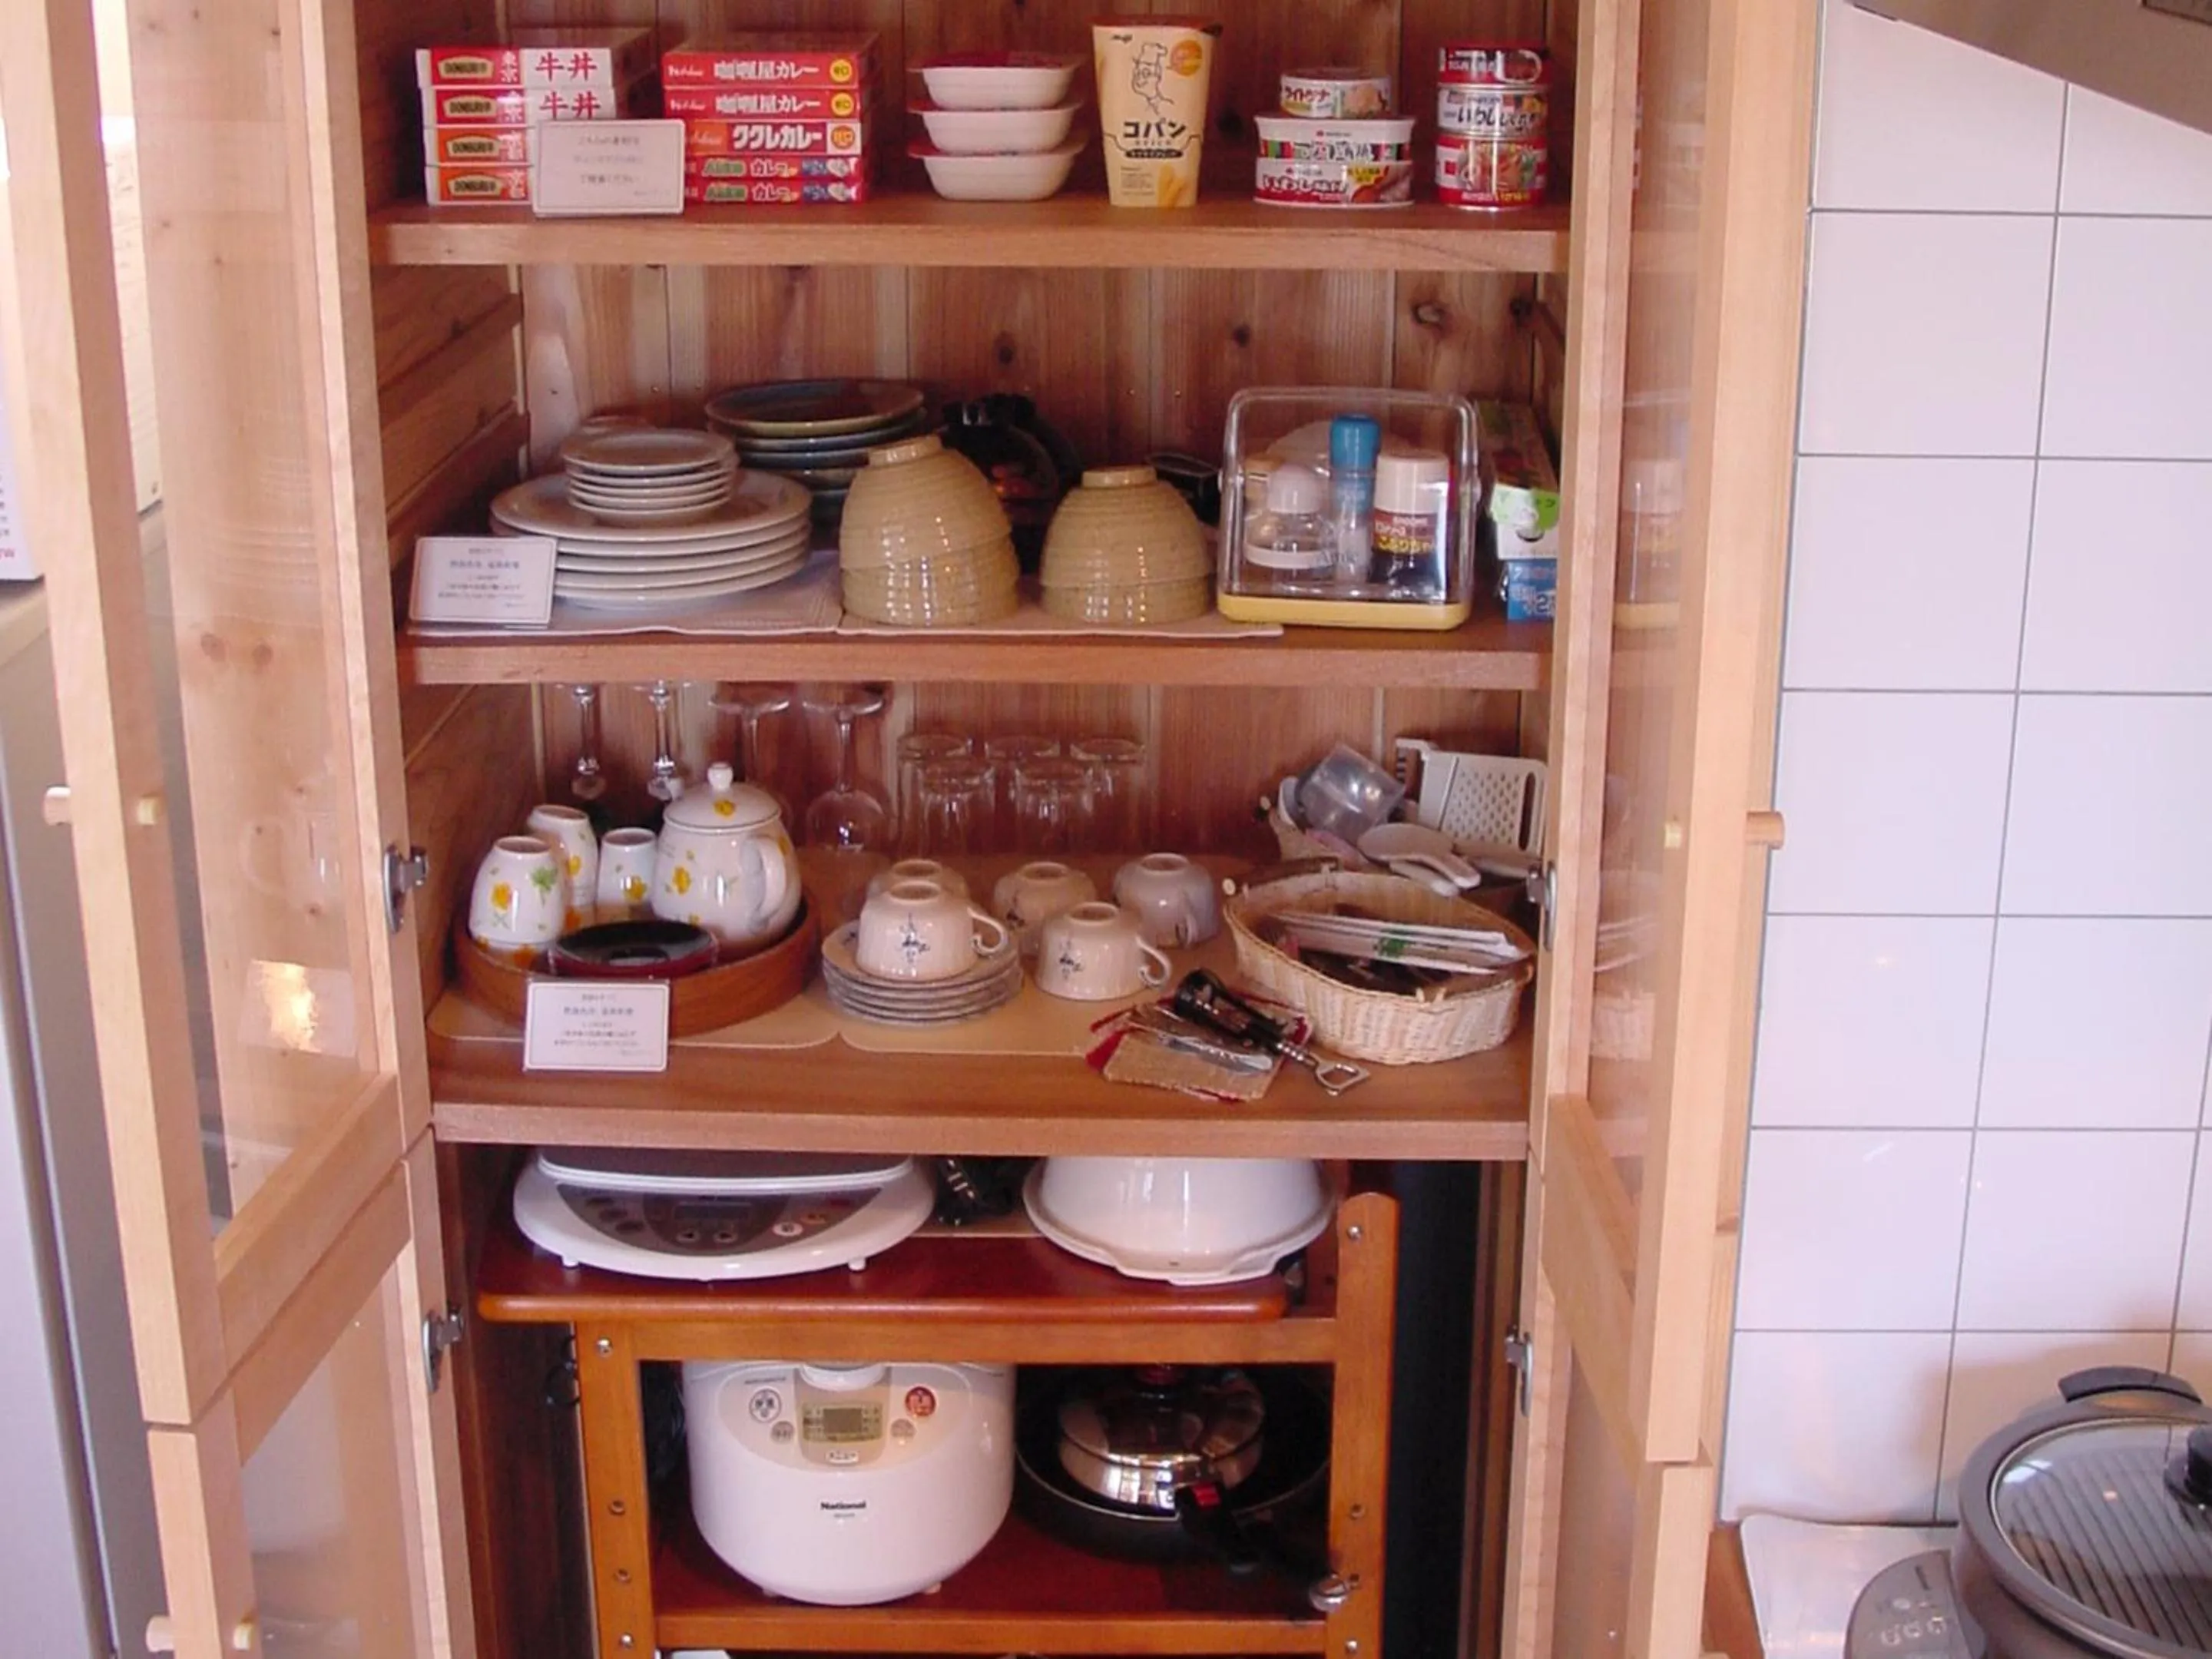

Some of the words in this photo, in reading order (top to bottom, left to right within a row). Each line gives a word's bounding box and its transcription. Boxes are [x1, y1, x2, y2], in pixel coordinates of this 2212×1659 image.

[732, 124, 823, 150] ククレカレー
[820, 1500, 866, 1511] National
